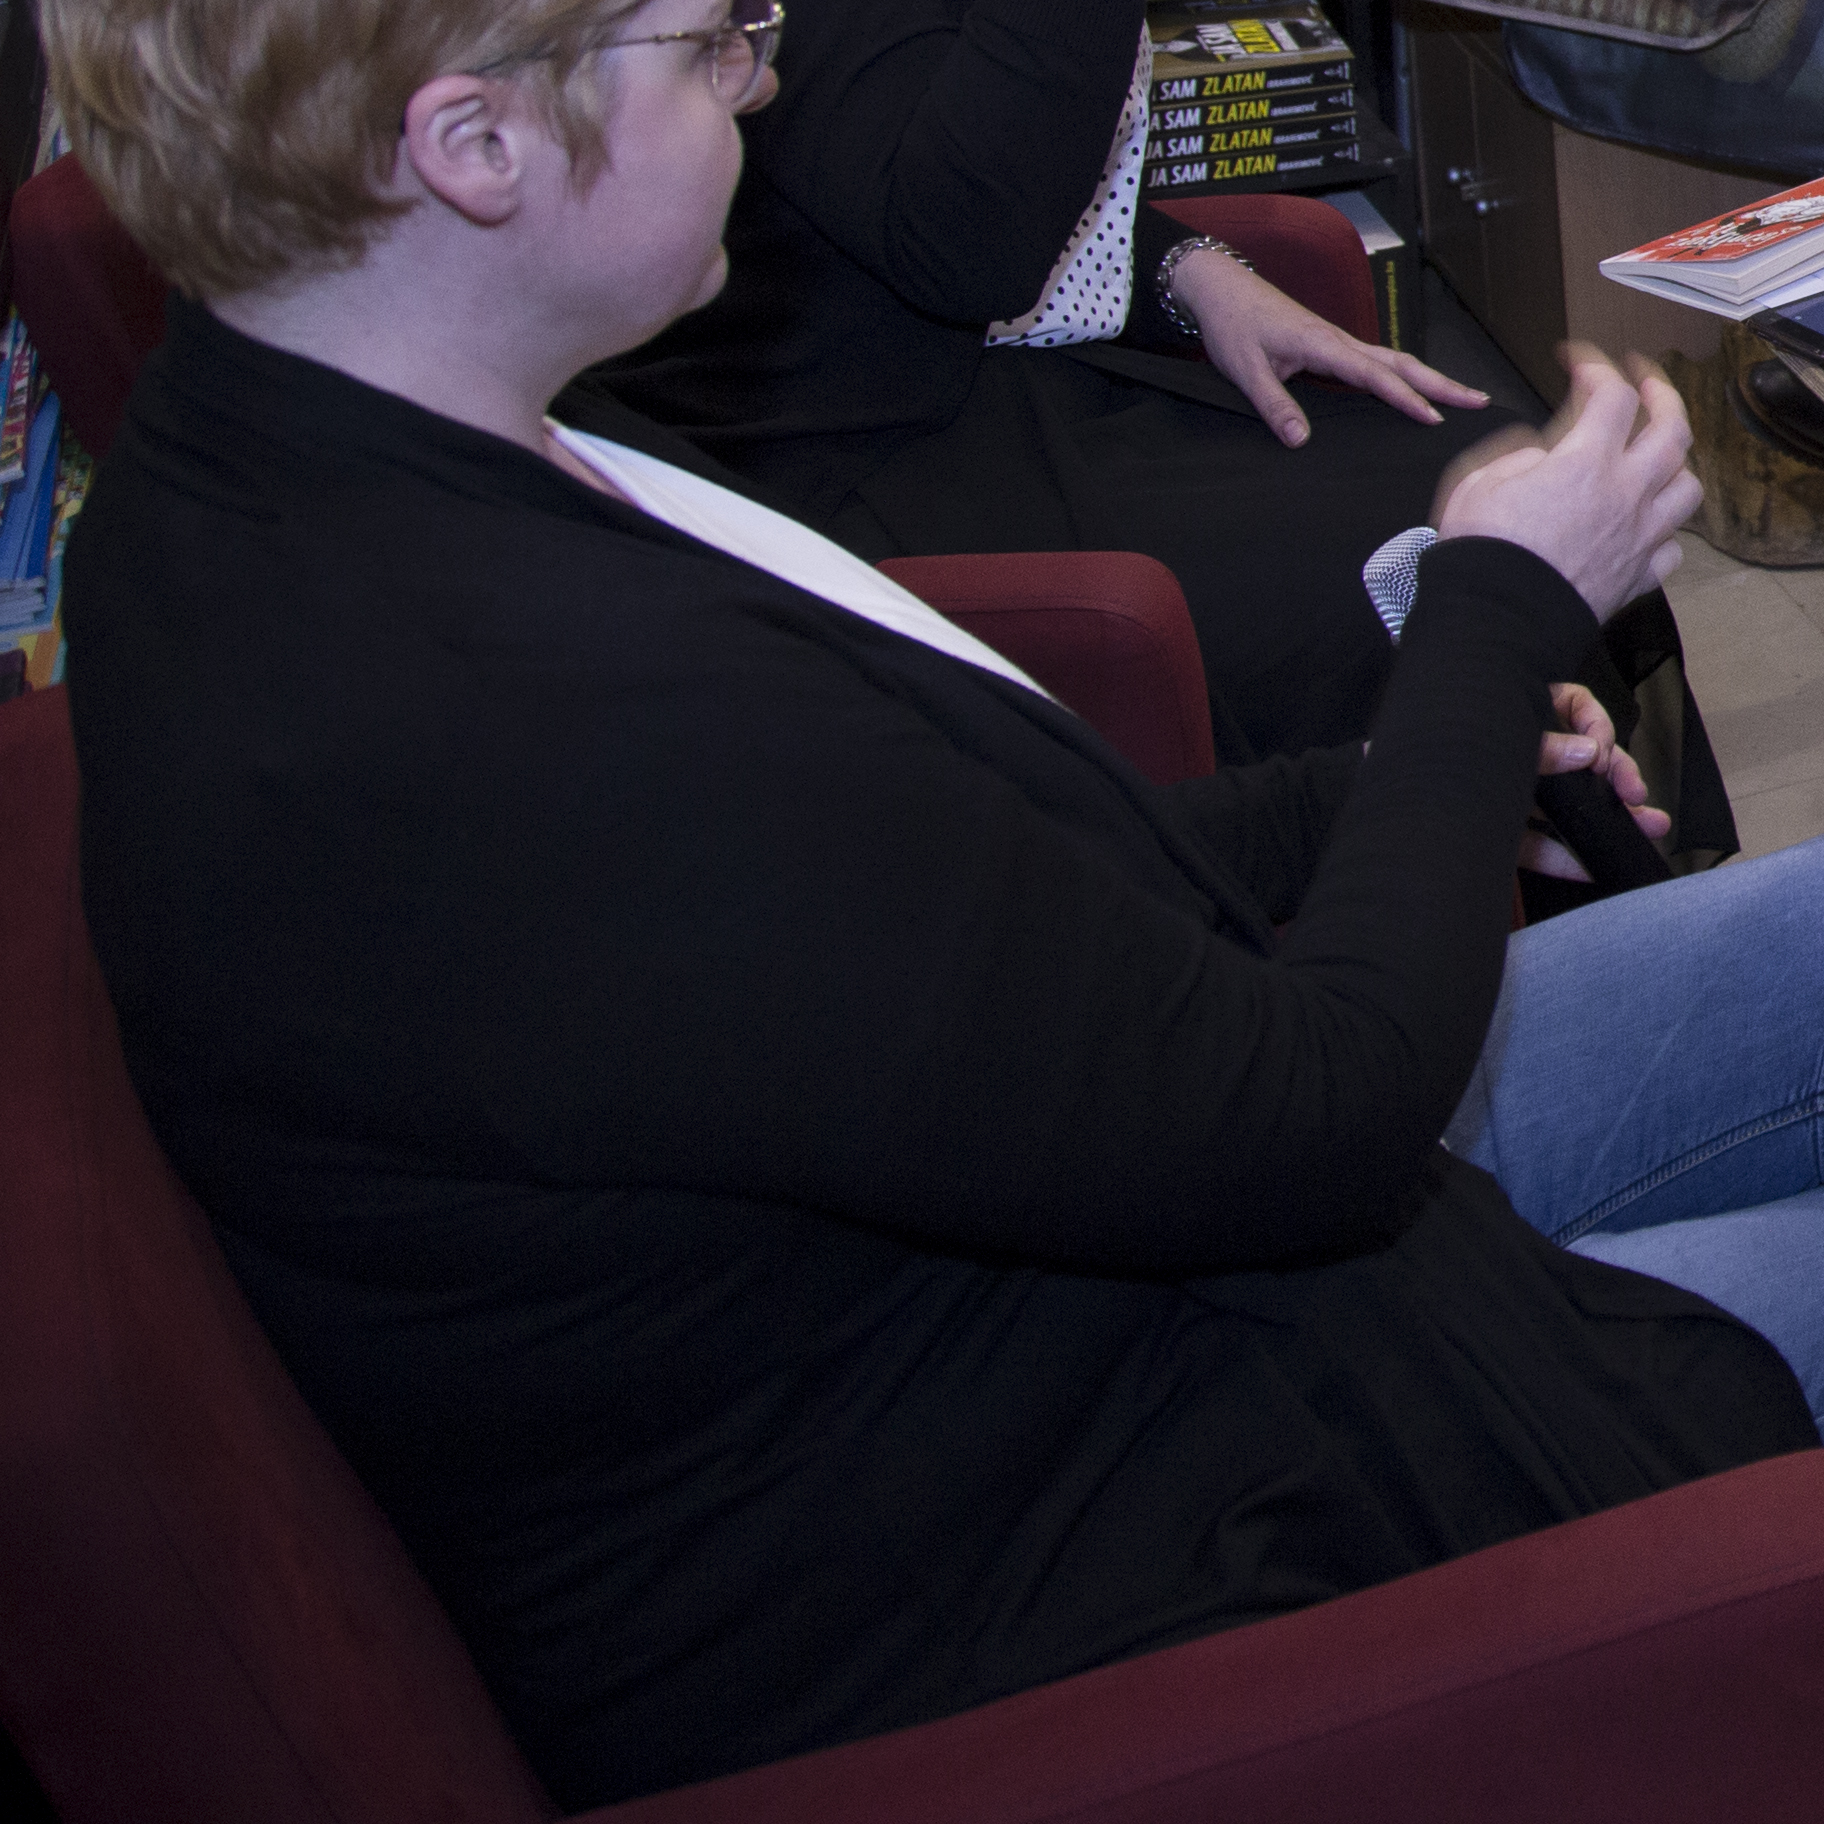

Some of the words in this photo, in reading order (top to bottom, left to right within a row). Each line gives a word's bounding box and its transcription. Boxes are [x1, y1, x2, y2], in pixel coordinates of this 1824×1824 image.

[1159, 78, 1198, 102] SAM
[1201, 70, 1267, 98] ZLATAN
[1163, 106, 1202, 131] SAM
[1205, 98, 1272, 126] ZLATAN
[1145, 139, 1165, 161] JA
[1166, 134, 1206, 159] SAM
[1209, 126, 1275, 154] ZLATAN
[1147, 167, 1169, 189] JA
[1170, 161, 1209, 186] SAM
[1212, 153, 1279, 181] ZLATAN
